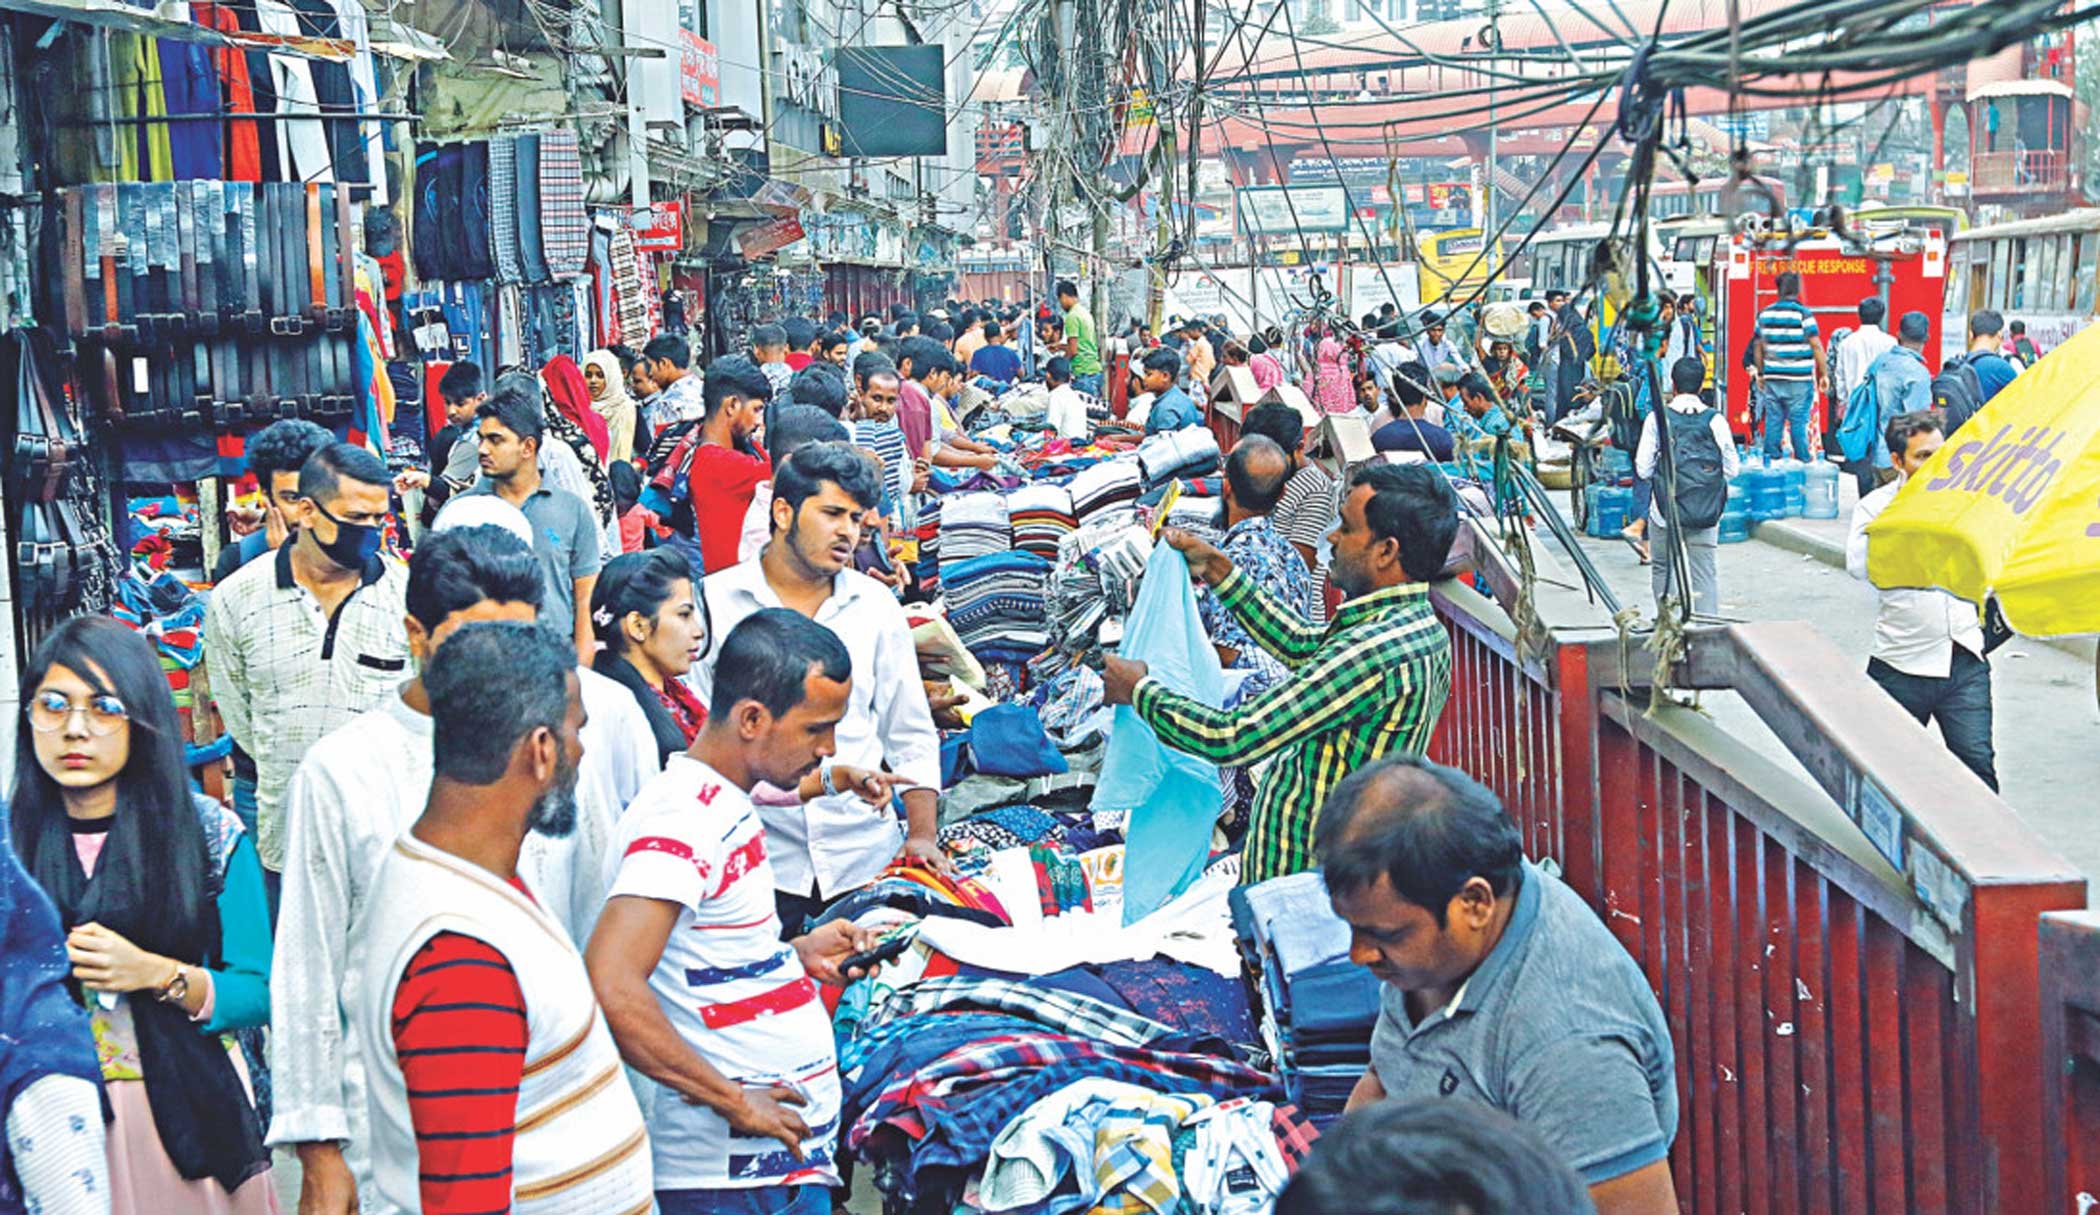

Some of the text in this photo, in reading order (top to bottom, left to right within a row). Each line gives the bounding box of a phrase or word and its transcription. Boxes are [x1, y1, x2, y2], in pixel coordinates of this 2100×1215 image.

[1750, 259, 1768, 275] FRE
[1818, 259, 1866, 274] RESPONSE
[1926, 423, 2066, 515] skitto
